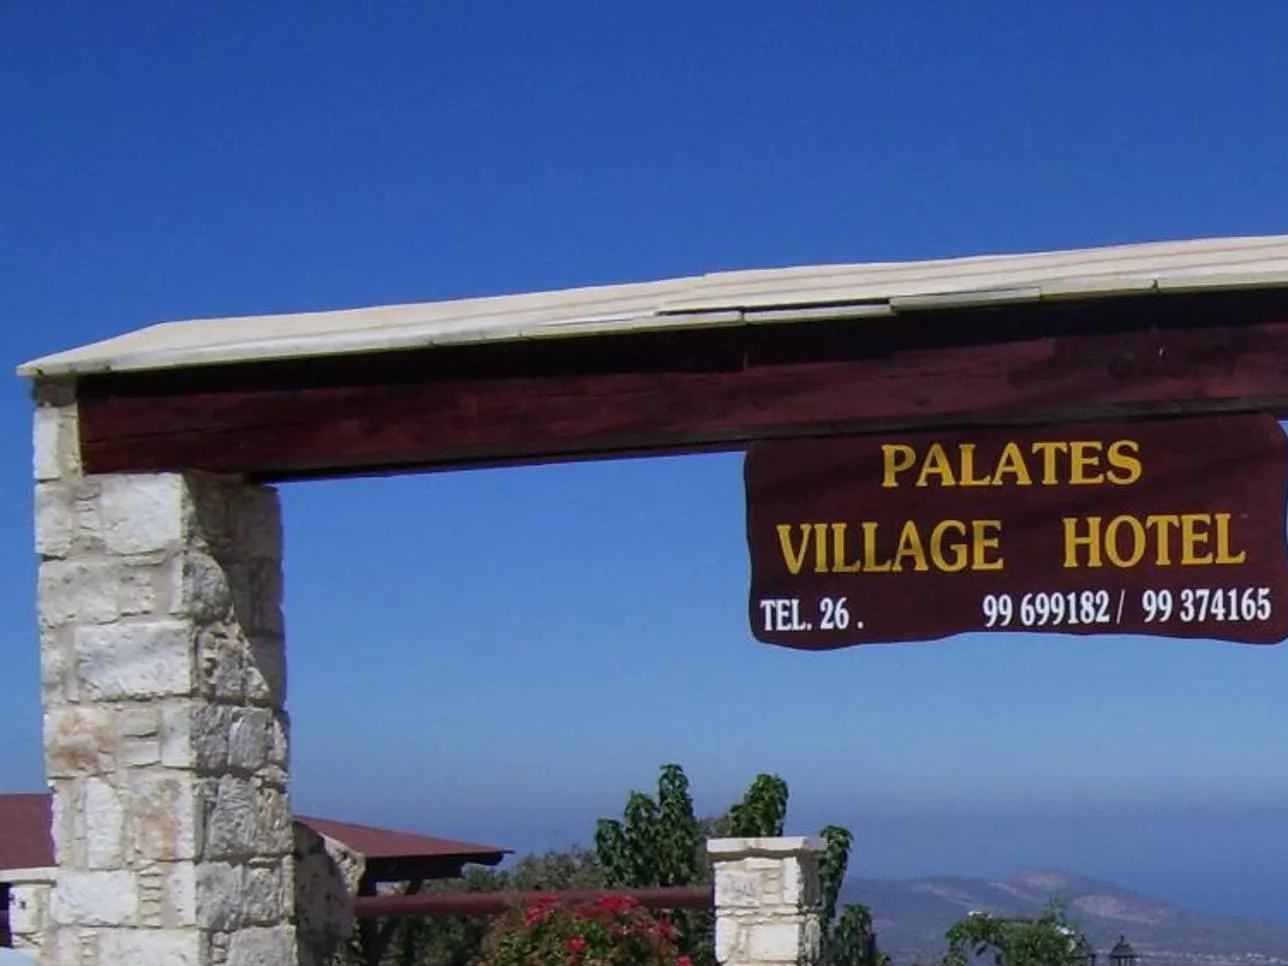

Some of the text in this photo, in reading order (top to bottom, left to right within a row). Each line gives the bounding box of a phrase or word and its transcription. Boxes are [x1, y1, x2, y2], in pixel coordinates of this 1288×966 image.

[880, 440, 1143, 488] PALATES
[776, 513, 1246, 575] VILLAGE HOTEL
[760, 598, 813, 631] TEL.
